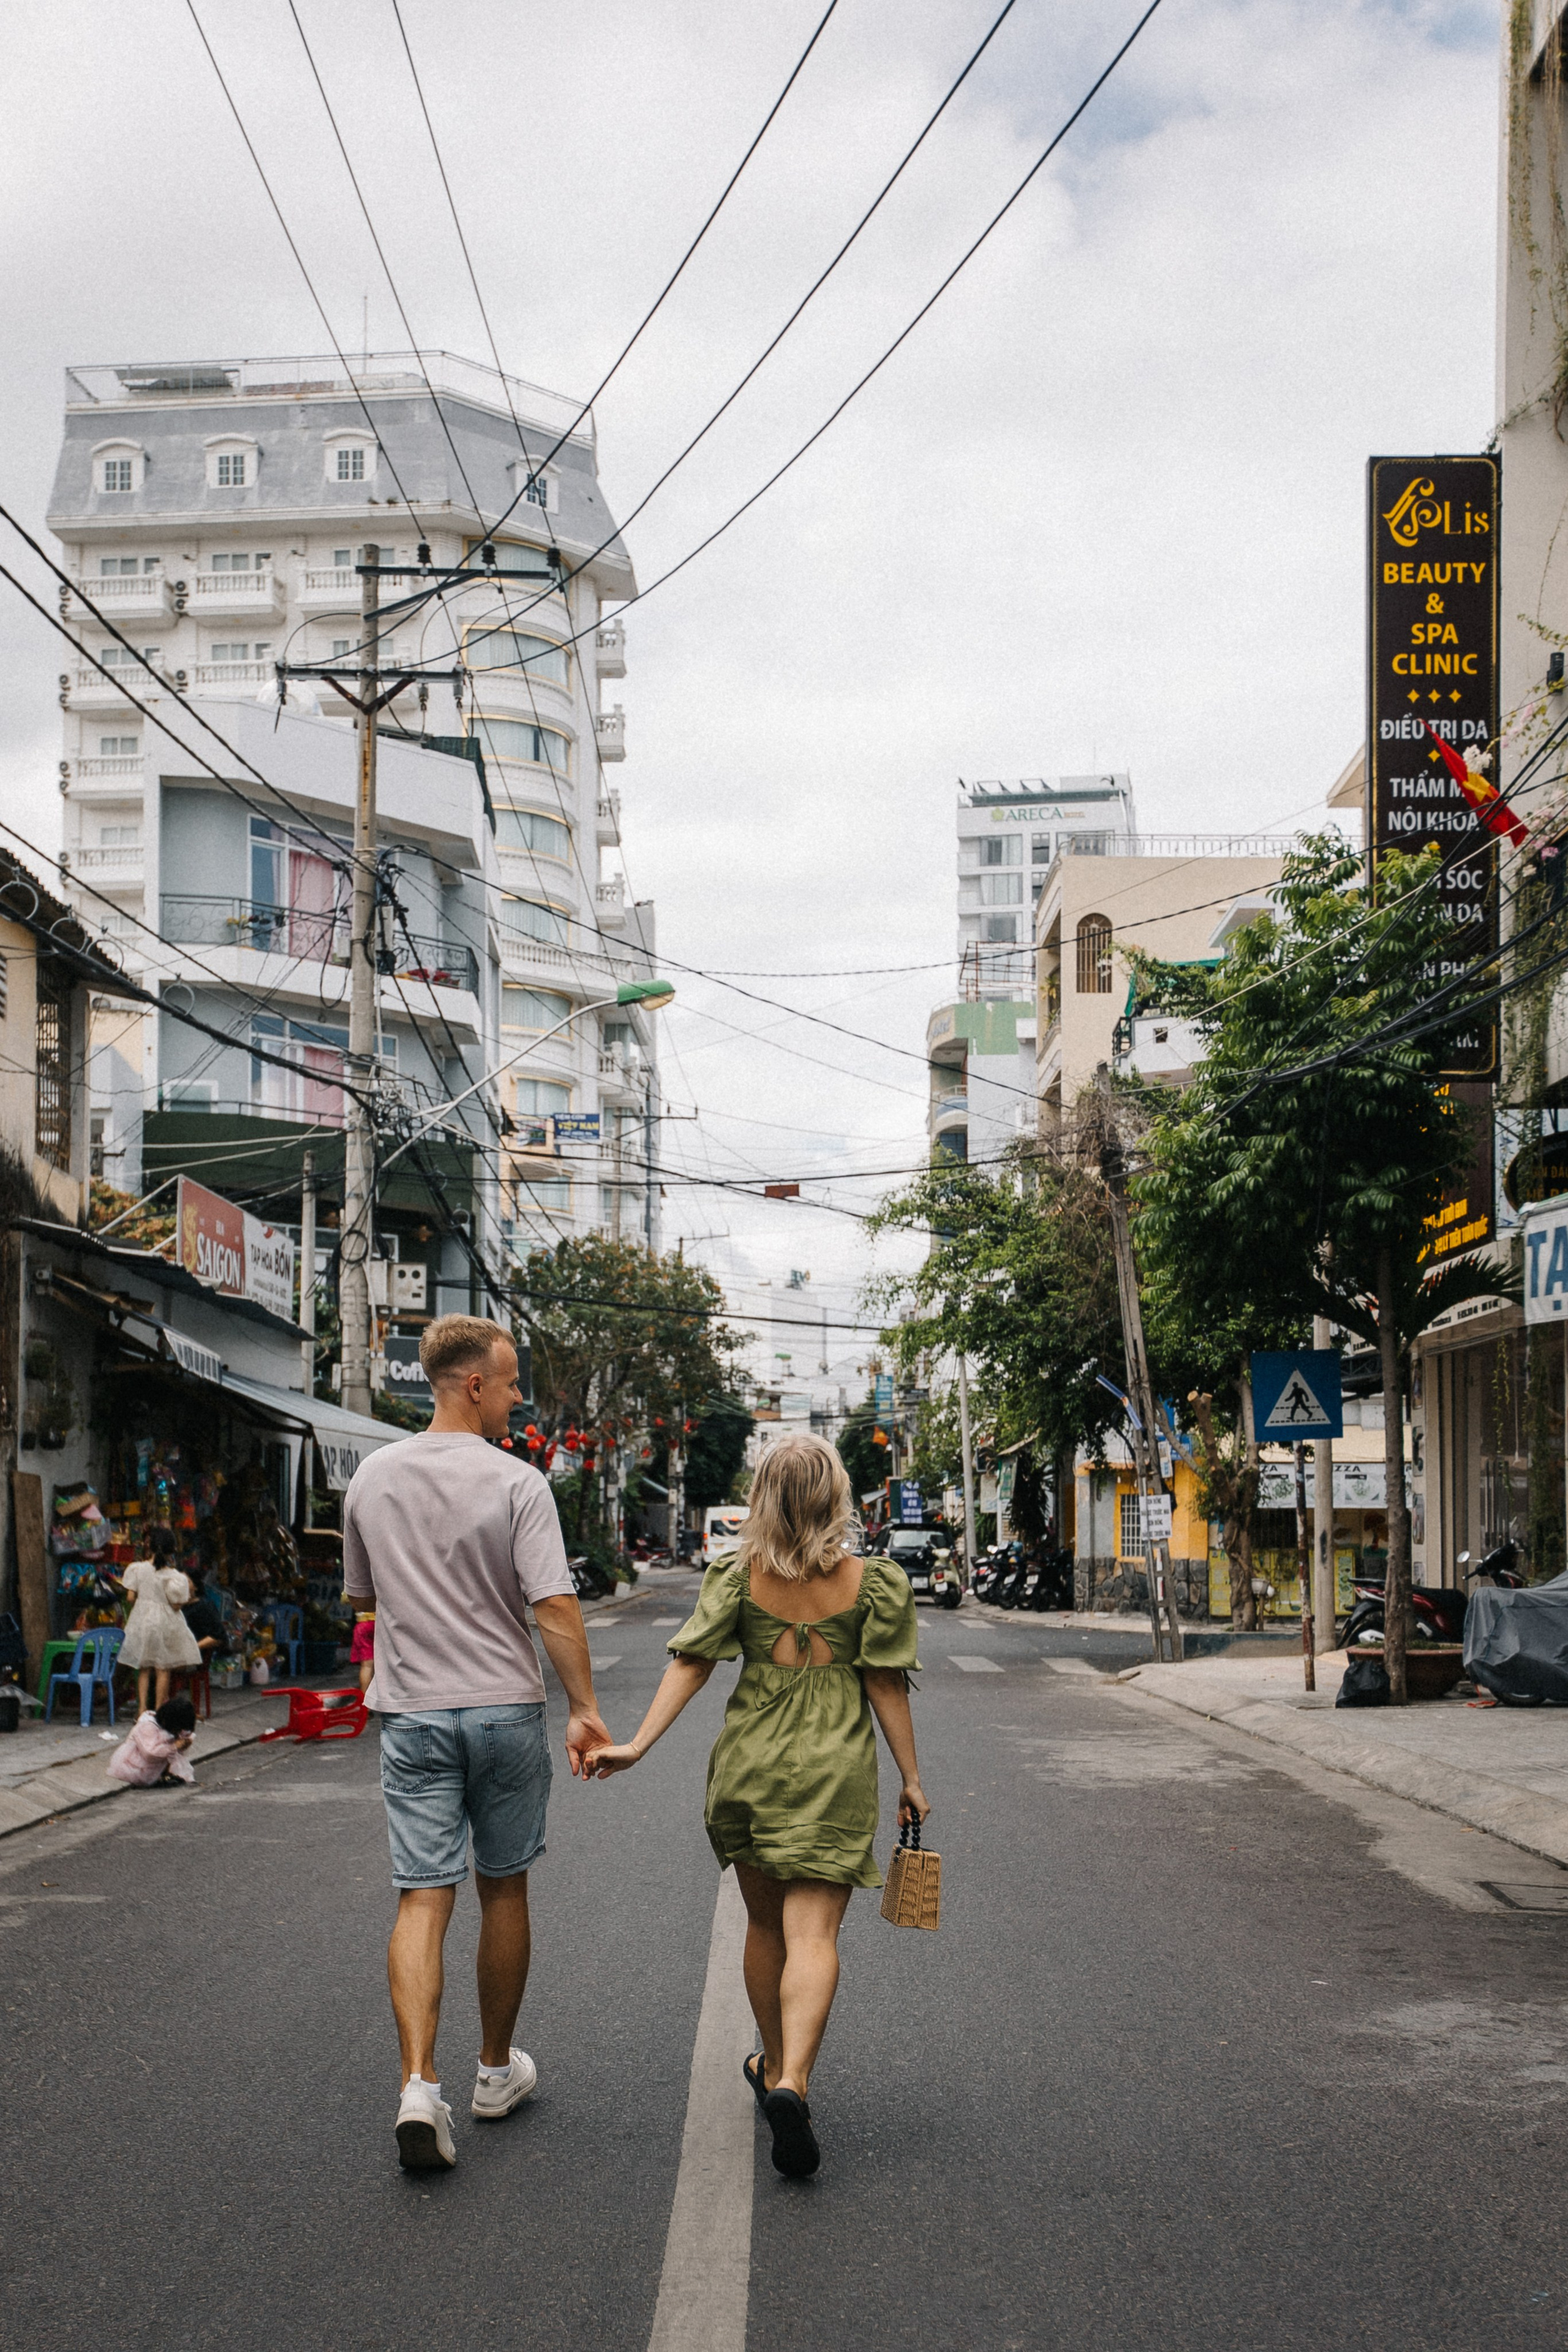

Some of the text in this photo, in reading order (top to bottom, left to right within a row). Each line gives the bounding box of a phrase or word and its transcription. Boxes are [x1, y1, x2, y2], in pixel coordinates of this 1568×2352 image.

[1384, 562, 1486, 584] BEAUTY
[1426, 593, 1444, 614] &
[1411, 624, 1458, 644] SPA
[1392, 654, 1477, 675] CLINIC
[1428, 720, 1457, 745] TRỊ
[1462, 720, 1488, 739] DA
[1449, 778, 1466, 797] M
[1006, 807, 1063, 821] ARECA
[1427, 811, 1480, 831] KHOA
[1446, 864, 1483, 889] SÓC
[1457, 903, 1483, 922] DA
[197, 1232, 241, 1290] SAIGON
[390, 1360, 429, 1382] Coff
[318, 1444, 336, 1485] ẠP
